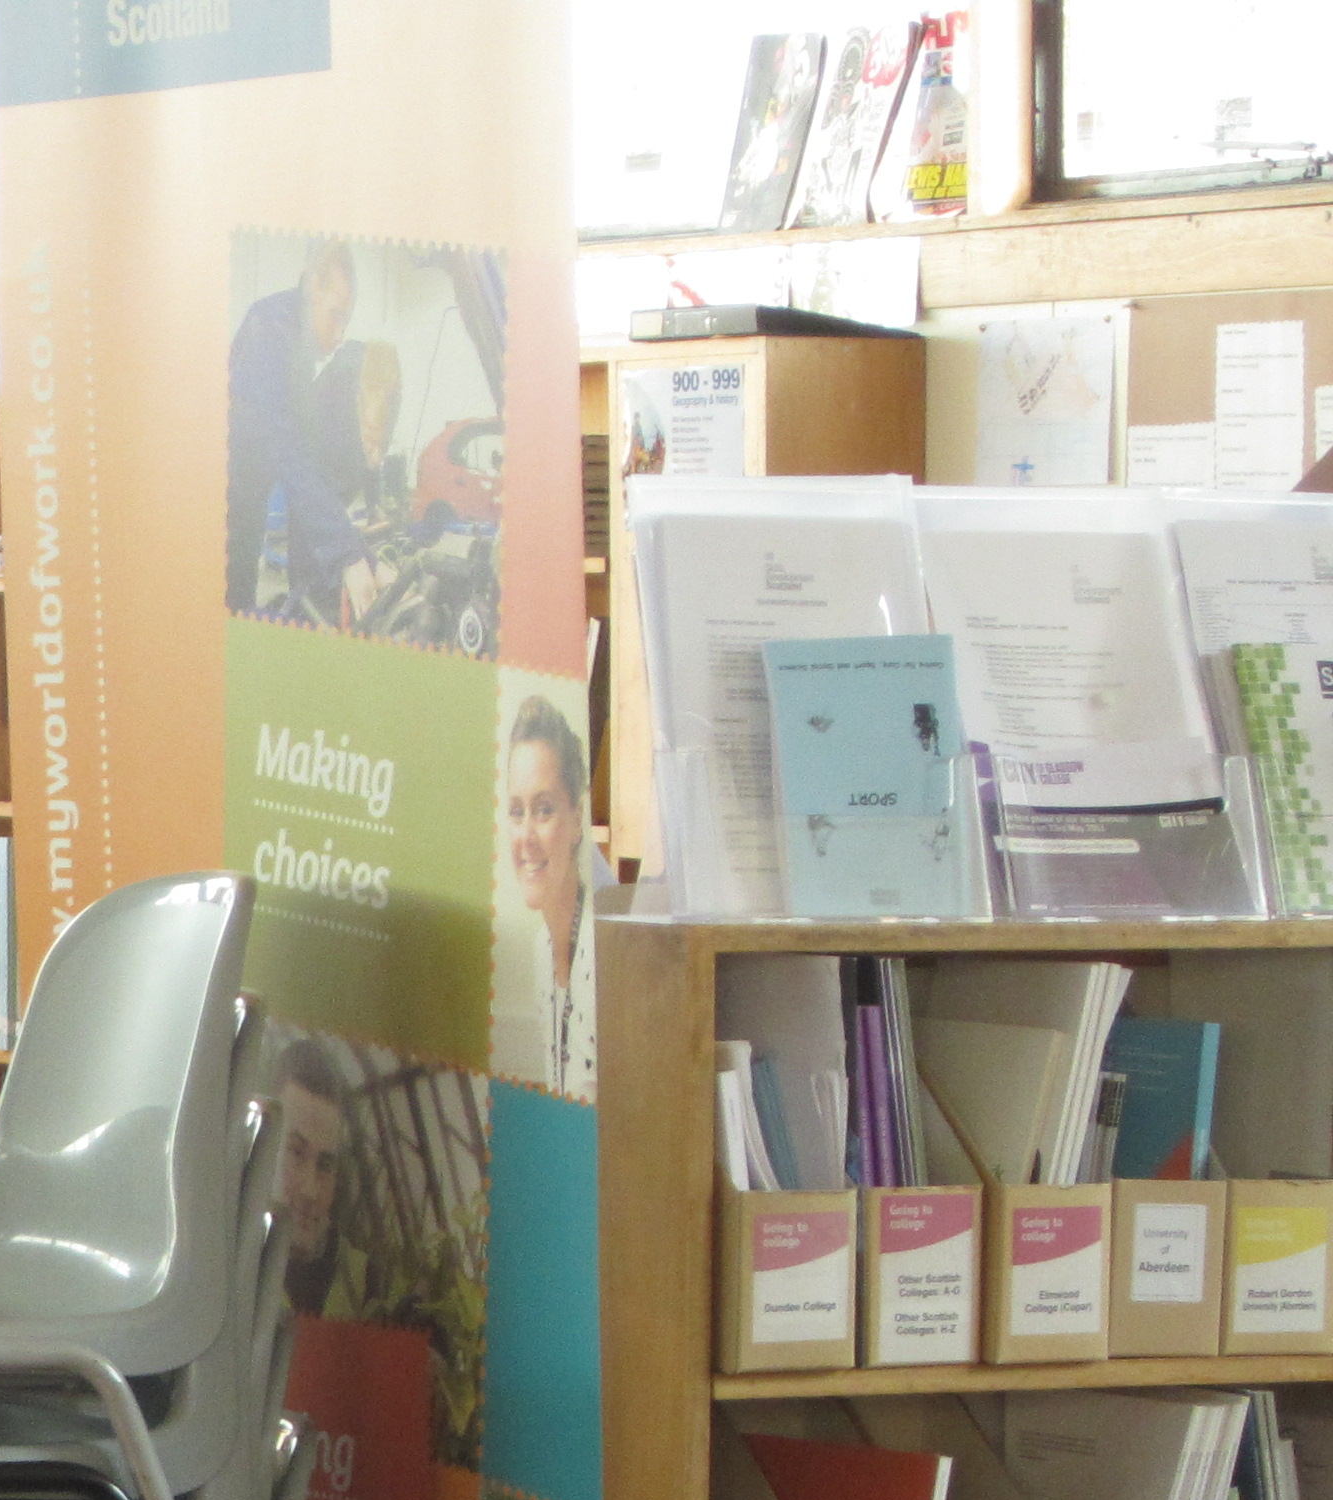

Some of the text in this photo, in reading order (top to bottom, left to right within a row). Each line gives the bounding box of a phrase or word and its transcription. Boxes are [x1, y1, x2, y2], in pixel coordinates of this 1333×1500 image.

[107, 0, 232, 47] Scotland
[672, 371, 700, 392] 900
[712, 368, 741, 390] 999
[256, 723, 396, 817] Making
[848, 792, 899, 806] SPORT
[253, 828, 391, 909] choices
[890, 1218, 926, 1231] college
[1053, 1216, 1063, 1228] to
[1143, 1227, 1189, 1241] University
[762, 1238, 800, 1249] college
[1160, 1244, 1171, 1256] of
[1138, 1261, 1190, 1273] Aberdeen
[925, 1273, 961, 1283] Scottish
[1247, 1289, 1279, 1300] Robert
[764, 1300, 836, 1313] Dundee College
[922, 1311, 959, 1322] Scottish
